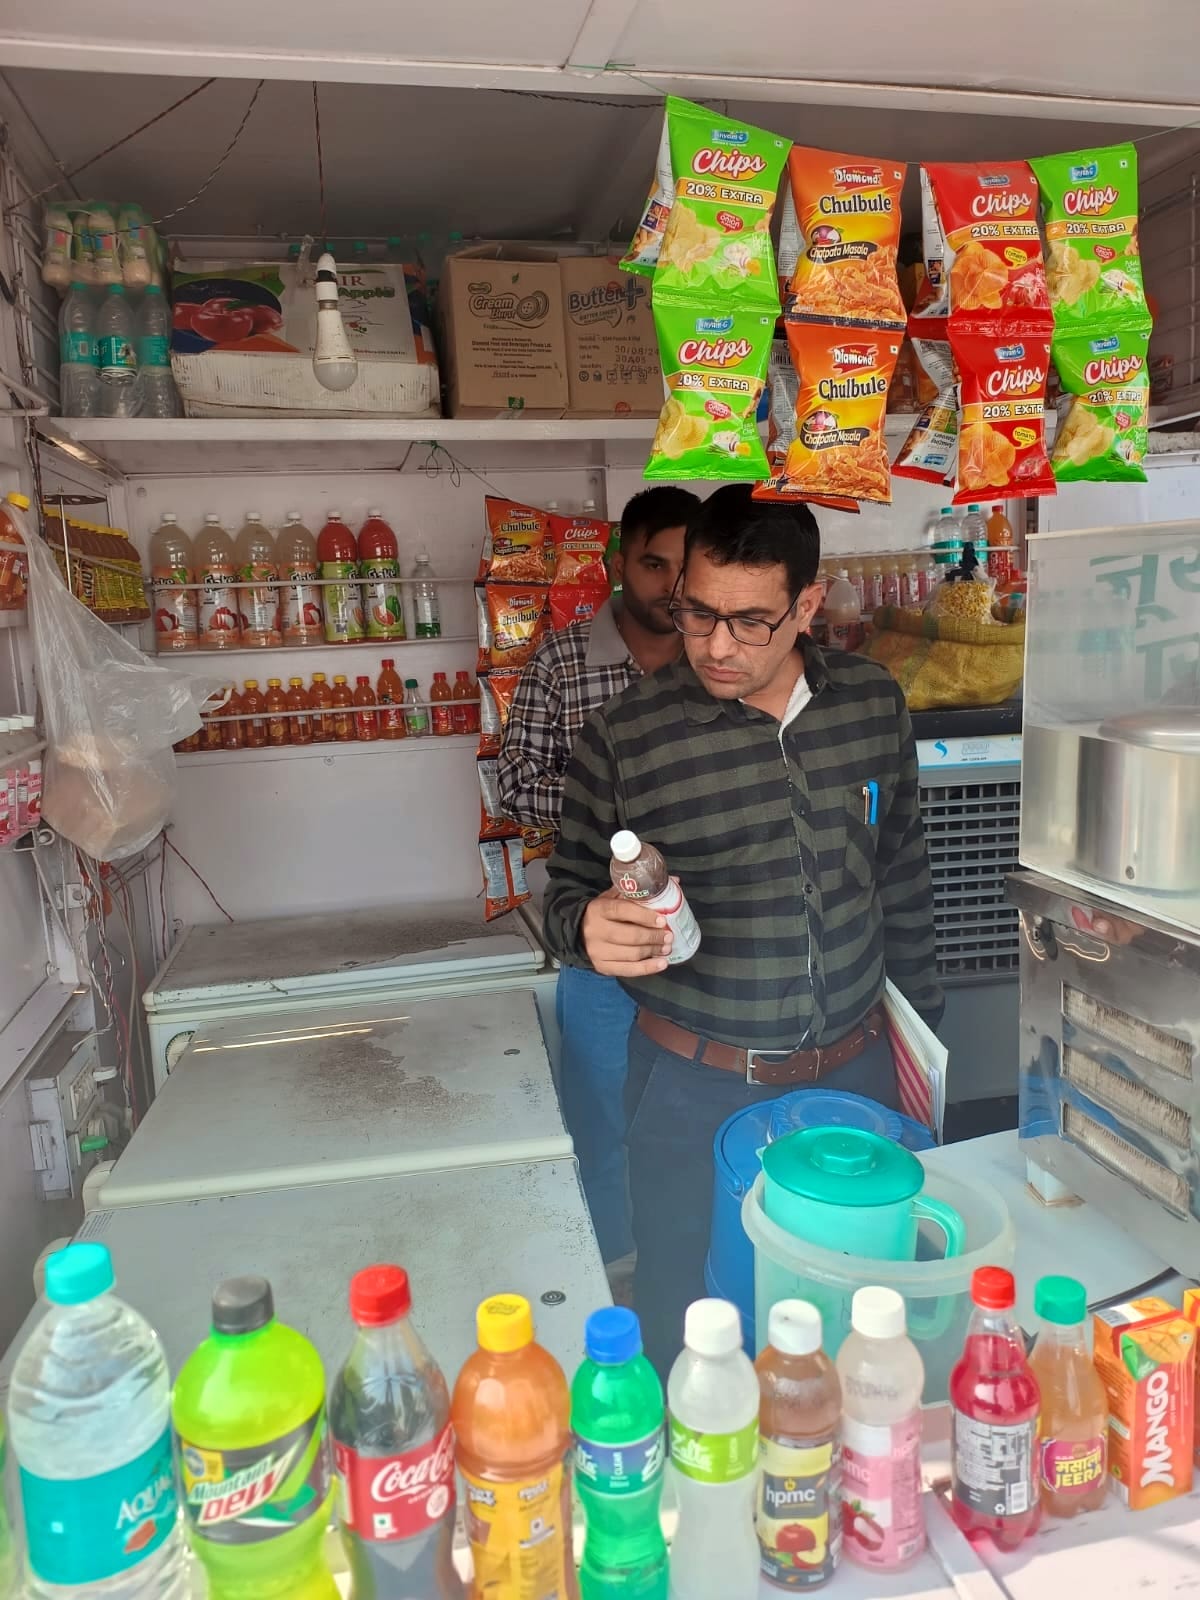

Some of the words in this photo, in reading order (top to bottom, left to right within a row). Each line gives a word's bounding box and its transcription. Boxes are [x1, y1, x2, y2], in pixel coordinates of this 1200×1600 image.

[692, 148, 766, 178] Chips
[833, 167, 881, 185] Diamond
[686, 183, 717, 198] 20%
[720, 189, 763, 204] EXTRA
[971, 190, 1032, 217] Chips
[1063, 185, 1119, 215] Chips
[819, 194, 892, 215] Chulbule
[971, 225, 1000, 237] 20%
[1003, 225, 1040, 236] EXTRA
[1066, 223, 1089, 234] 20%
[1092, 222, 1126, 234] EXTRA
[810, 245, 842, 261] Chatpata
[842, 243, 869, 256] Masala
[473, 296, 514, 311] Cream
[678, 338, 752, 367] Chips
[833, 347, 876, 366] Diamond
[986, 364, 1045, 396] Chips
[1084, 354, 1143, 386] Chips
[708, 376, 750, 391] EXTRA
[818, 376, 887, 400] Chulbule
[1088, 391, 1114, 403] 20%
[1116, 390, 1142, 401] EXTRA
[983, 404, 1011, 418] 20%
[1014, 403, 1044, 416] EXTR
[804, 432, 838, 447] Chatpata
[837, 430, 861, 443] Masala
[500, 522, 540, 532] Chulbule
[564, 527, 600, 540] Chips
[1140, 1370, 1175, 1488] MANGO
[187, 1453, 274, 1503] Mountain
[1054, 1467, 1102, 1489] JEERA
[765, 1485, 817, 1508] hpmc
